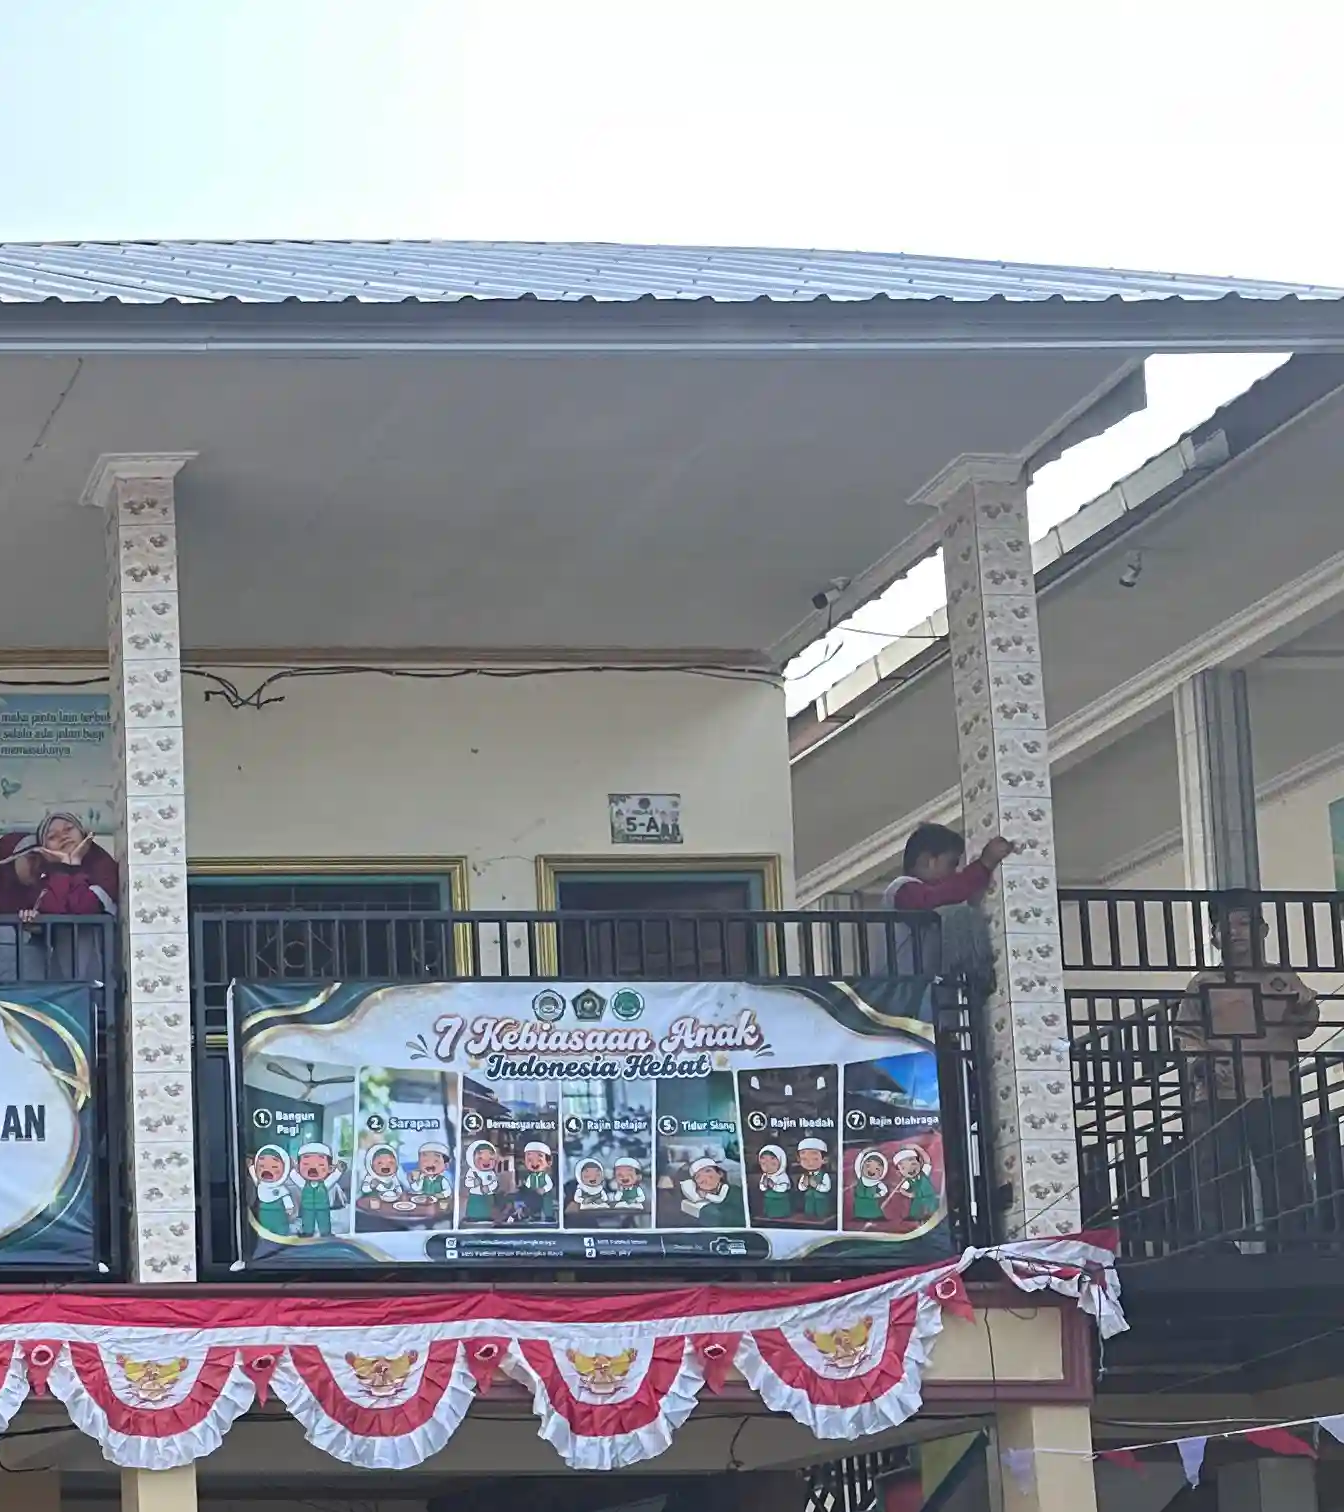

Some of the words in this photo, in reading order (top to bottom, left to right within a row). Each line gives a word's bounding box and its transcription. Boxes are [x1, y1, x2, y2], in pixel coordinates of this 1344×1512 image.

[625, 817, 660, 832] 5-A
[435, 1016, 463, 1058] 7
[468, 1016, 652, 1053] Kebiasaan
[661, 1011, 761, 1052] Anak
[487, 1053, 619, 1078] Indonesia
[621, 1053, 710, 1078] Hebat
[275, 1111, 315, 1123] Bangun
[770, 1117, 797, 1130] Rajin
[799, 1117, 834, 1128] Ibadah
[869, 1115, 892, 1128] Rajin
[895, 1115, 940, 1127] Olahraga
[276, 1124, 300, 1137] Pagi
[389, 1118, 439, 1132] Sarapan
[486, 1119, 556, 1131] Bermasyarakat
[586, 1120, 611, 1132] Rajin
[614, 1119, 648, 1132] Belajar
[681, 1121, 706, 1132] Tidur
[710, 1121, 736, 1133] Siang
